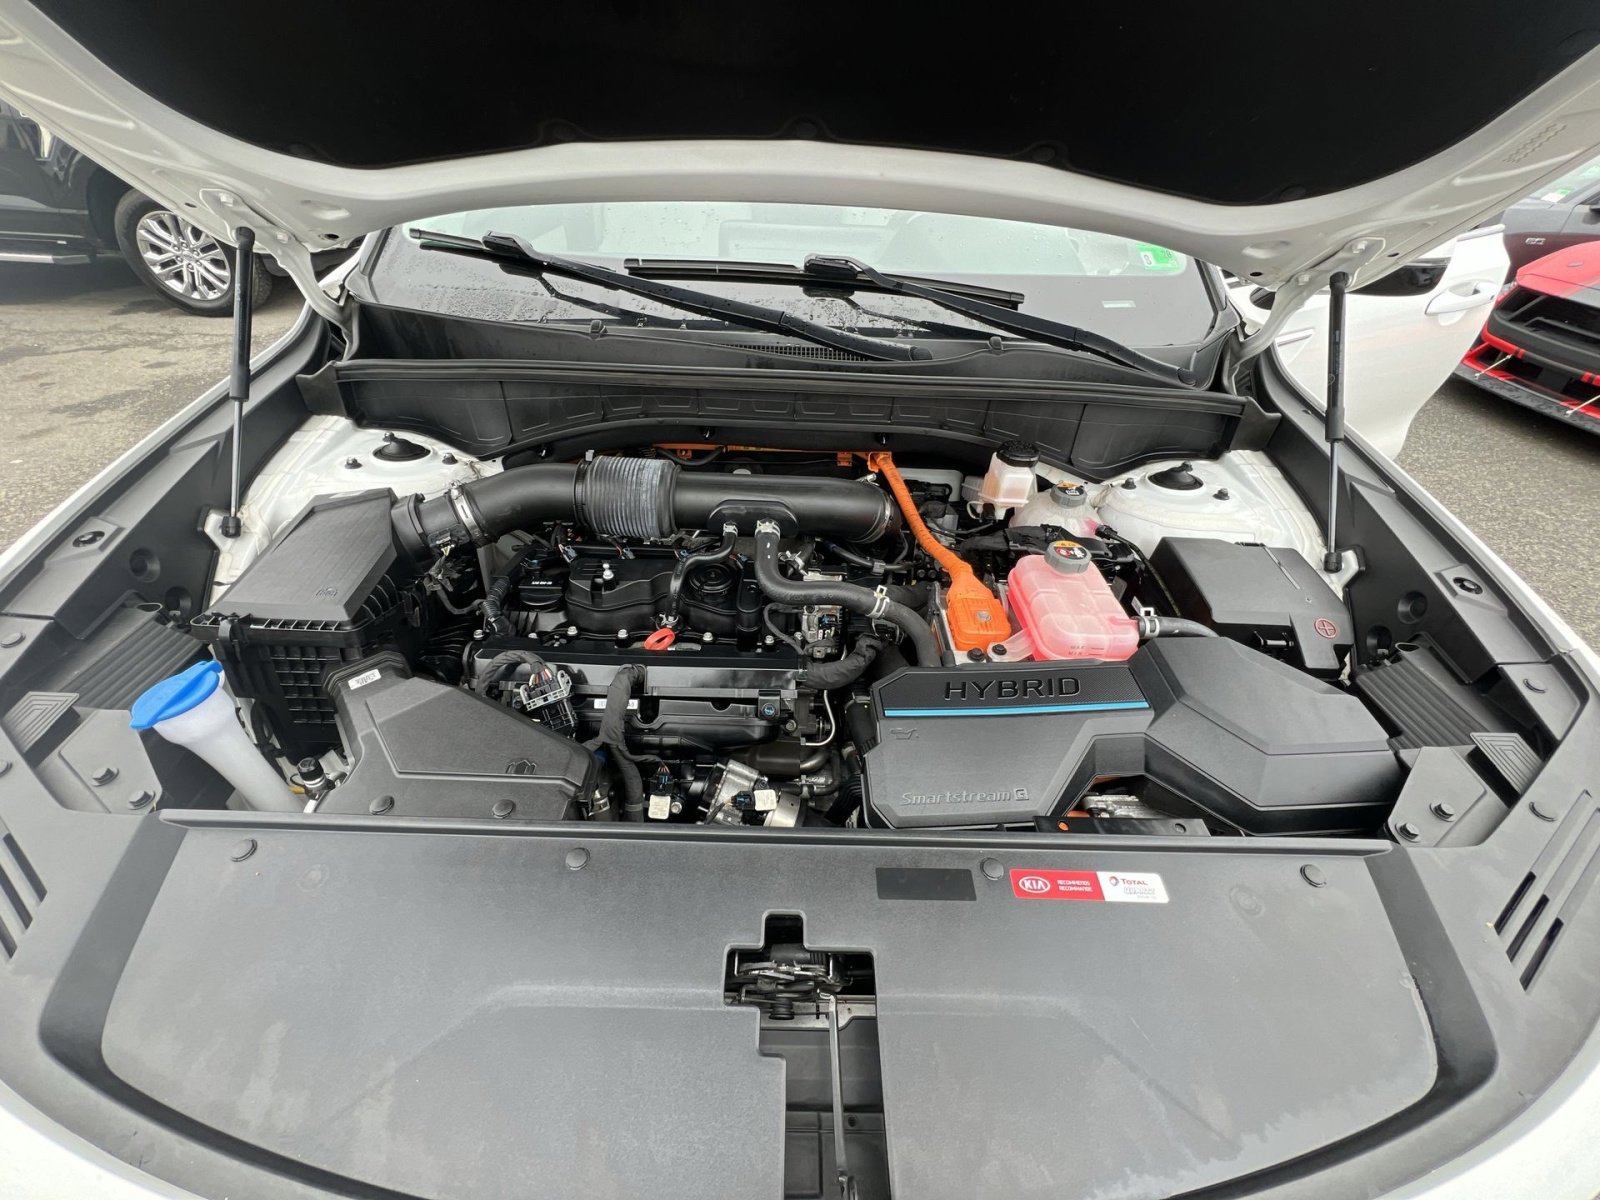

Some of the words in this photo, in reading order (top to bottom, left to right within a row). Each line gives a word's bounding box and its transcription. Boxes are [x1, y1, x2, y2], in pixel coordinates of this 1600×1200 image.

[944, 677, 1081, 700] HYBRID
[901, 790, 1011, 805] Smartstream
[1022, 879, 1047, 890] KIA
